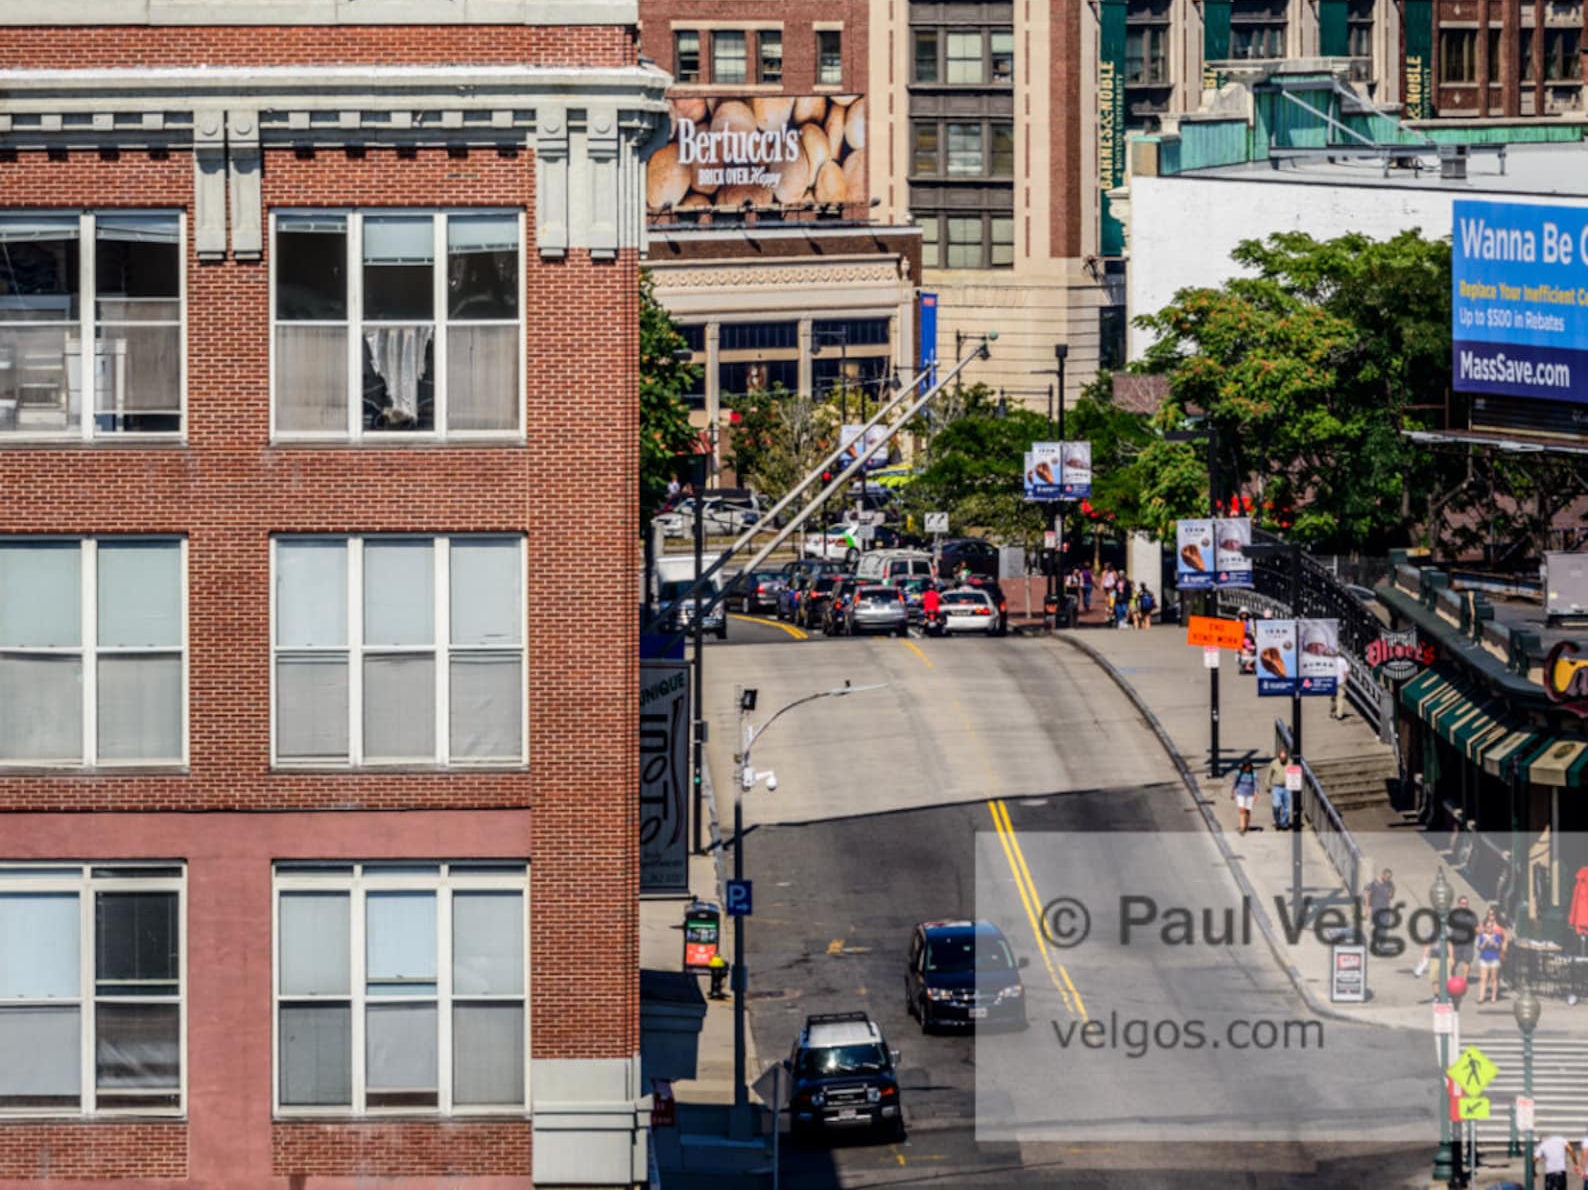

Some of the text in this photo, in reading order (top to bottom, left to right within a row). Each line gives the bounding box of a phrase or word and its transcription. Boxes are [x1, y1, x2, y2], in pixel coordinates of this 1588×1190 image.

[677, 118, 801, 164] Bertucci's
[1460, 218, 1536, 263] Wanna
[1542, 222, 1573, 266] Be
[1459, 280, 1497, 302] Replace
[1499, 282, 1521, 300] Your
[1523, 284, 1575, 306] Inefficient
[1459, 307, 1565, 332] Up to $500 in Rebates
[1459, 350, 1571, 388] MassSave.com
[729, 885, 747, 908] P
